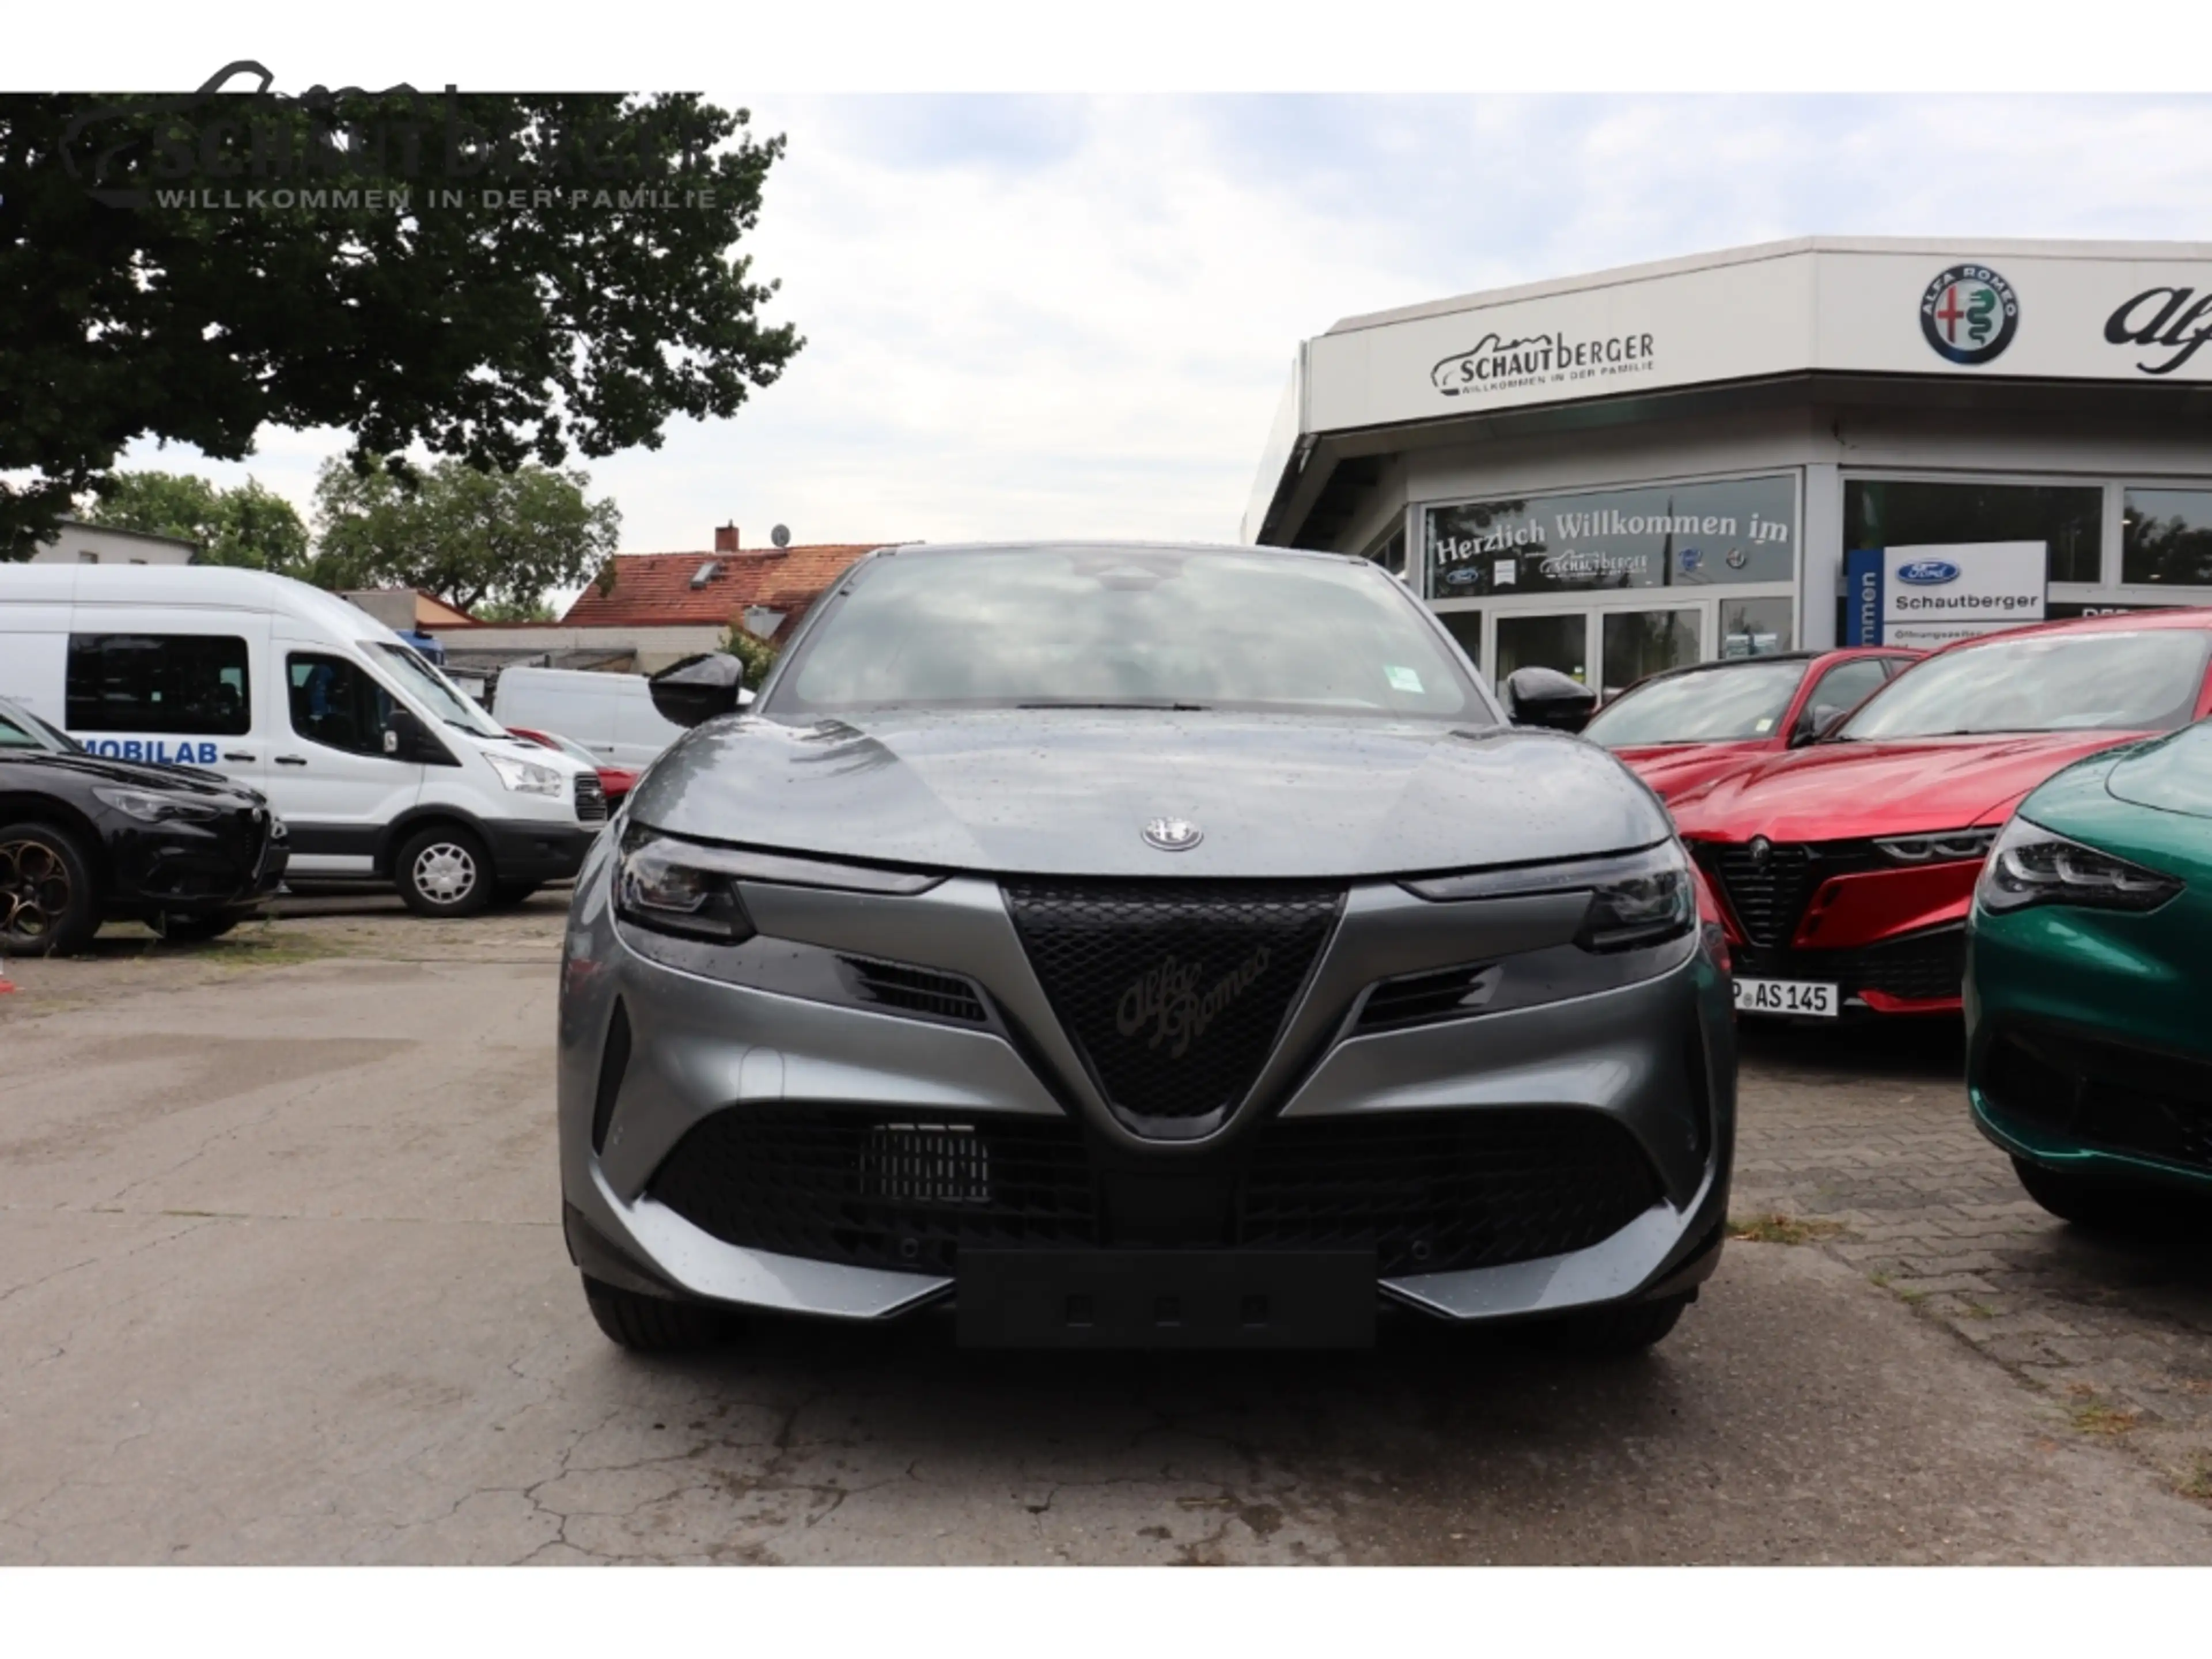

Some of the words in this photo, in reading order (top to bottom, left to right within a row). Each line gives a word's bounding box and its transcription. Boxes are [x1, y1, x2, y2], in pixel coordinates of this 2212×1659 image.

[1922, 272, 1956, 315] ALFA
[1963, 267, 2017, 316] ROMEO
[1461, 376, 1546, 394] WILLKOMMEN
[1551, 373, 1565, 382] IN
[1570, 369, 1596, 380] DER
[1437, 517, 1546, 565] Herzlich
[1555, 510, 1736, 540] Willkommen
[1749, 513, 1788, 543] im
[1896, 593, 2038, 611] Schautberger
[1756, 983, 1782, 1007] AS
[1786, 984, 1827, 1011] 145
